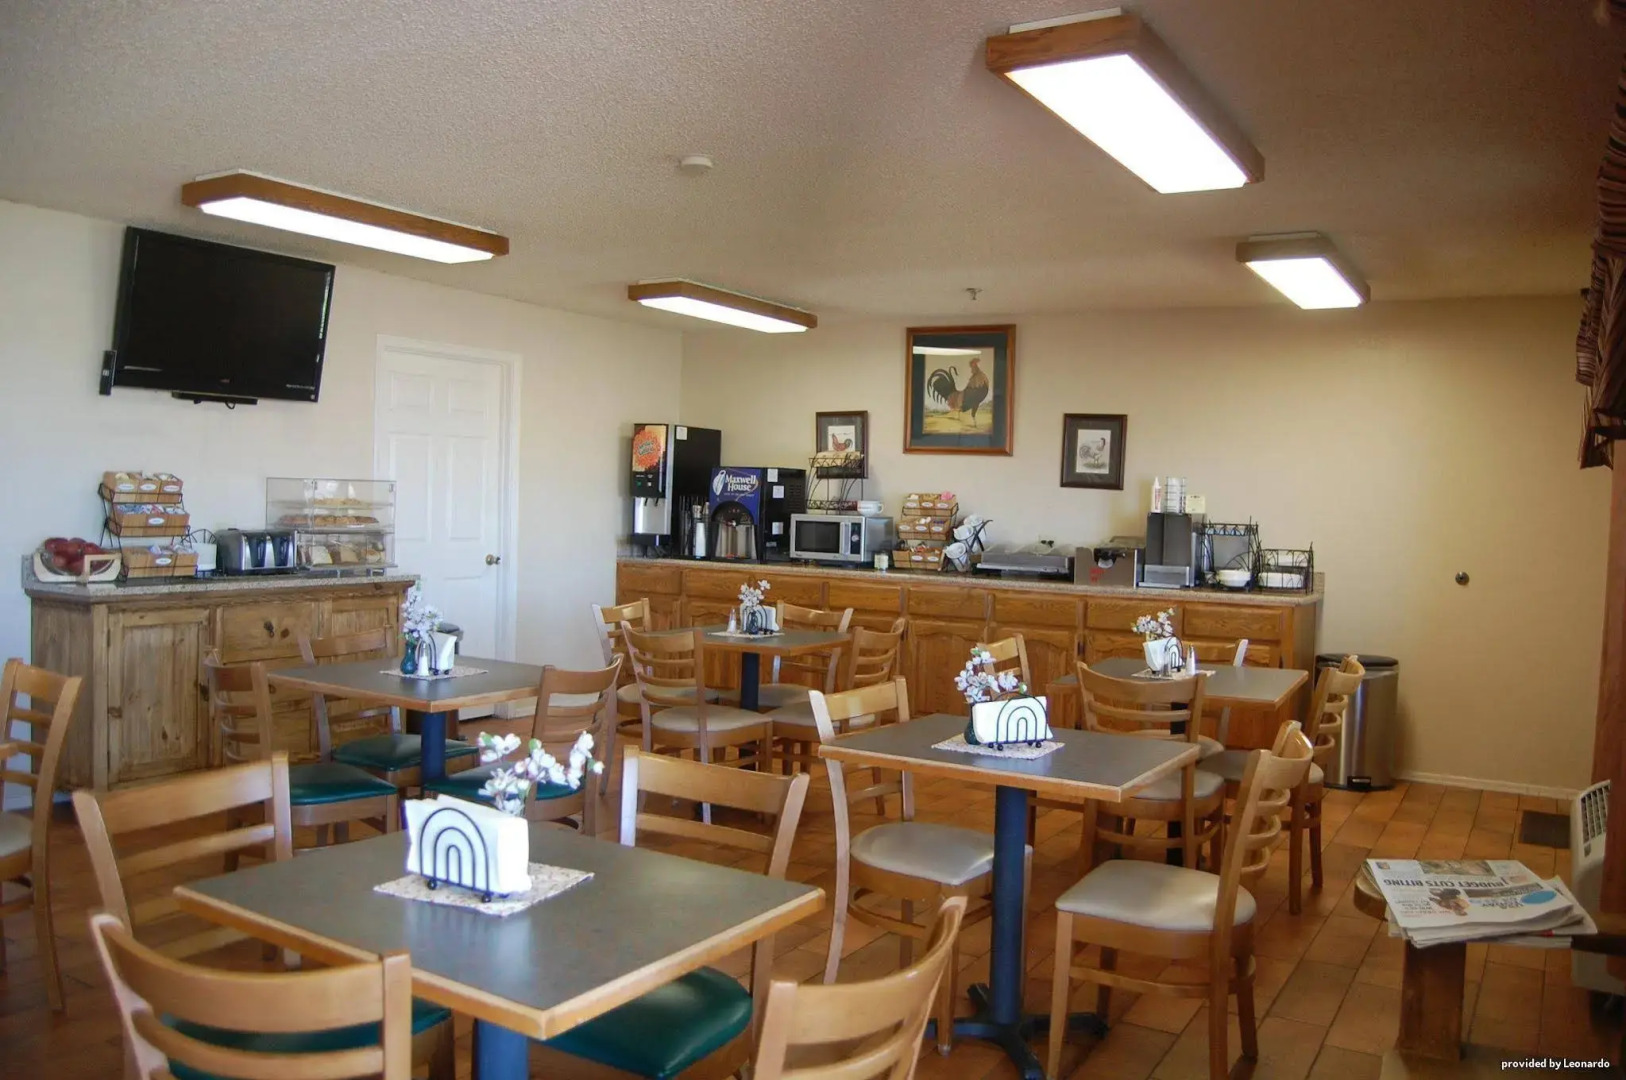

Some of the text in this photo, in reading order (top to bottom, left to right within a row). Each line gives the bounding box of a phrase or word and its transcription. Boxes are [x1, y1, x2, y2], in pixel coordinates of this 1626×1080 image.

[725, 474, 757, 484] Maxwell
[727, 482, 752, 492] House
[1383, 879, 1424, 887] BITING
[1459, 880, 1504, 888] BUDGET
